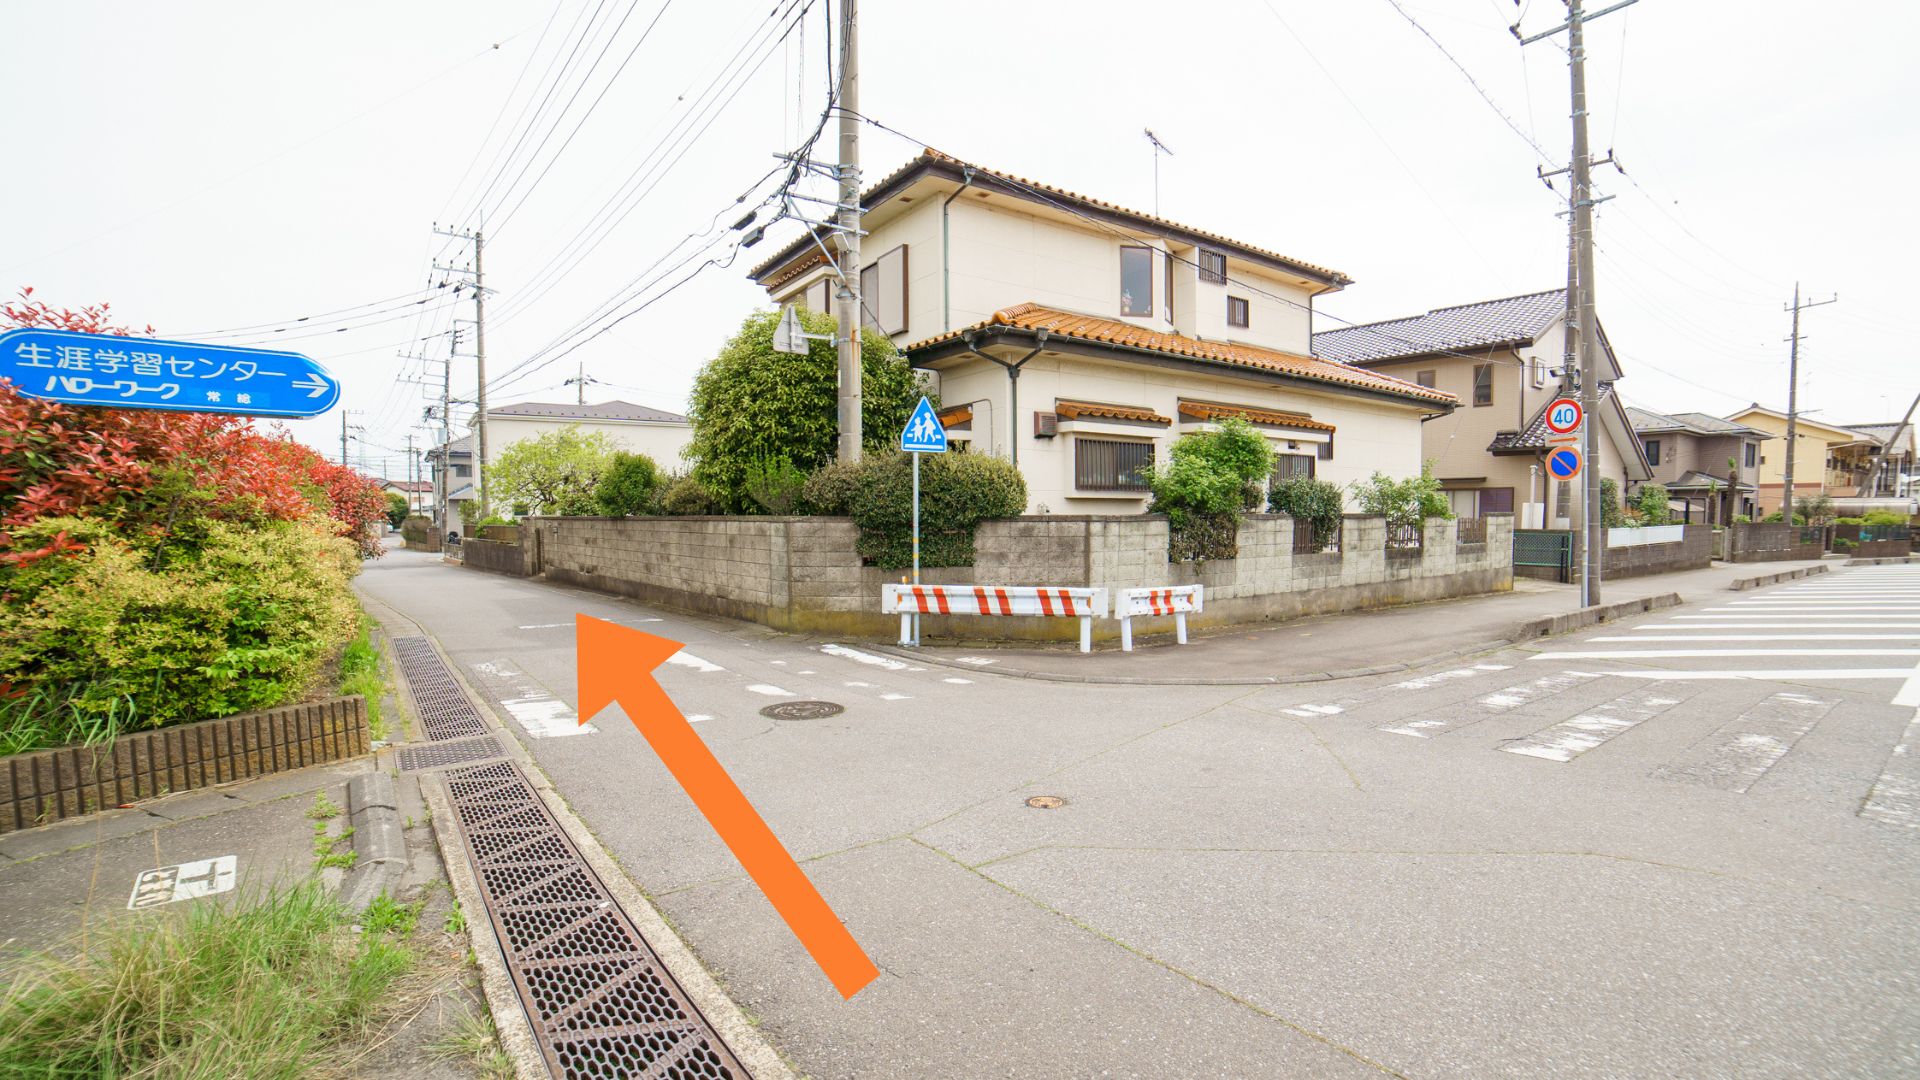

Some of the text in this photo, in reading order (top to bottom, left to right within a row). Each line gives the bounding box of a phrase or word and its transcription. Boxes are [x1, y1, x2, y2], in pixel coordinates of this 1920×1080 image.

[15, 342, 287, 381] 生涯学習センター
[45, 376, 180, 400] ハローワーク
[1554, 408, 1574, 424] 40
